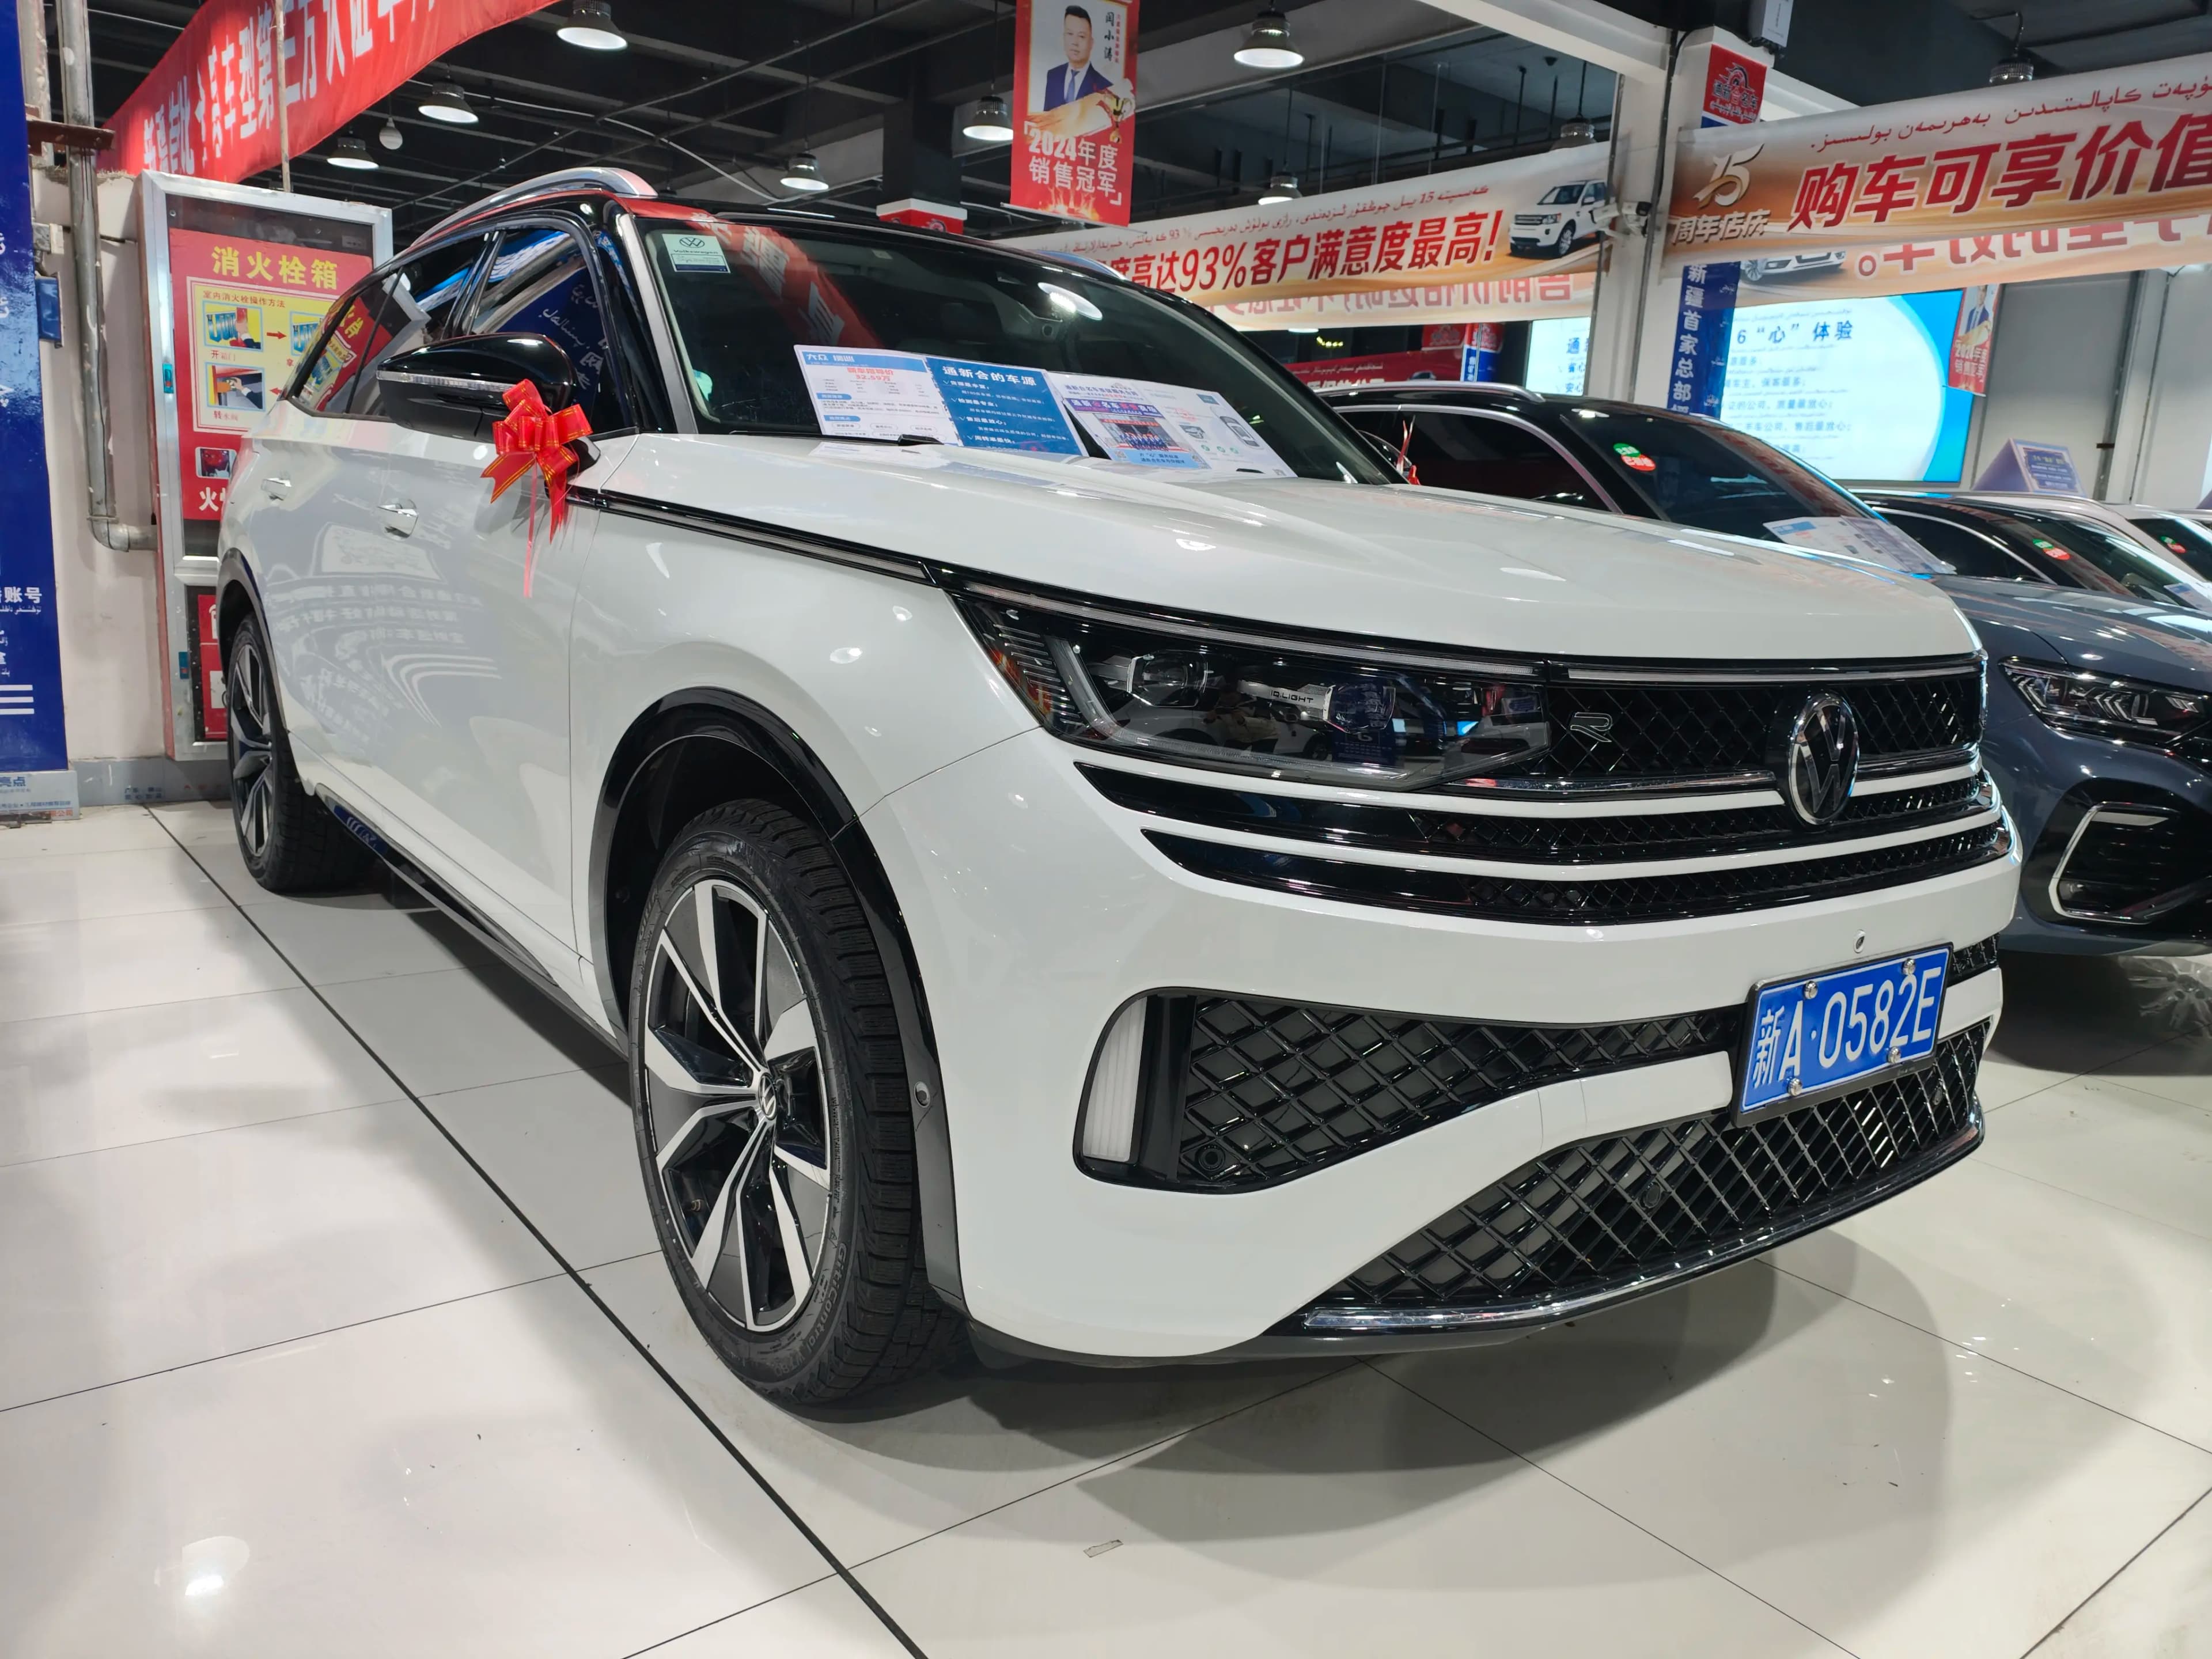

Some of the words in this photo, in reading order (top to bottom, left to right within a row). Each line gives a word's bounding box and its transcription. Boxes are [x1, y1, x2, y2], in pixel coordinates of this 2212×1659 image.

[1787, 112, 2212, 232] 购车可享价值
[211, 246, 338, 289] 消火栓箱
[203, 290, 286, 308] 室内消火栓操作方法
[1812, 320, 1853, 342] 体验
[942, 365, 1037, 387] 通新合的车源
[0, 586, 43, 604] 账号
[1271, 690, 1314, 703] IQ.LIGHT
